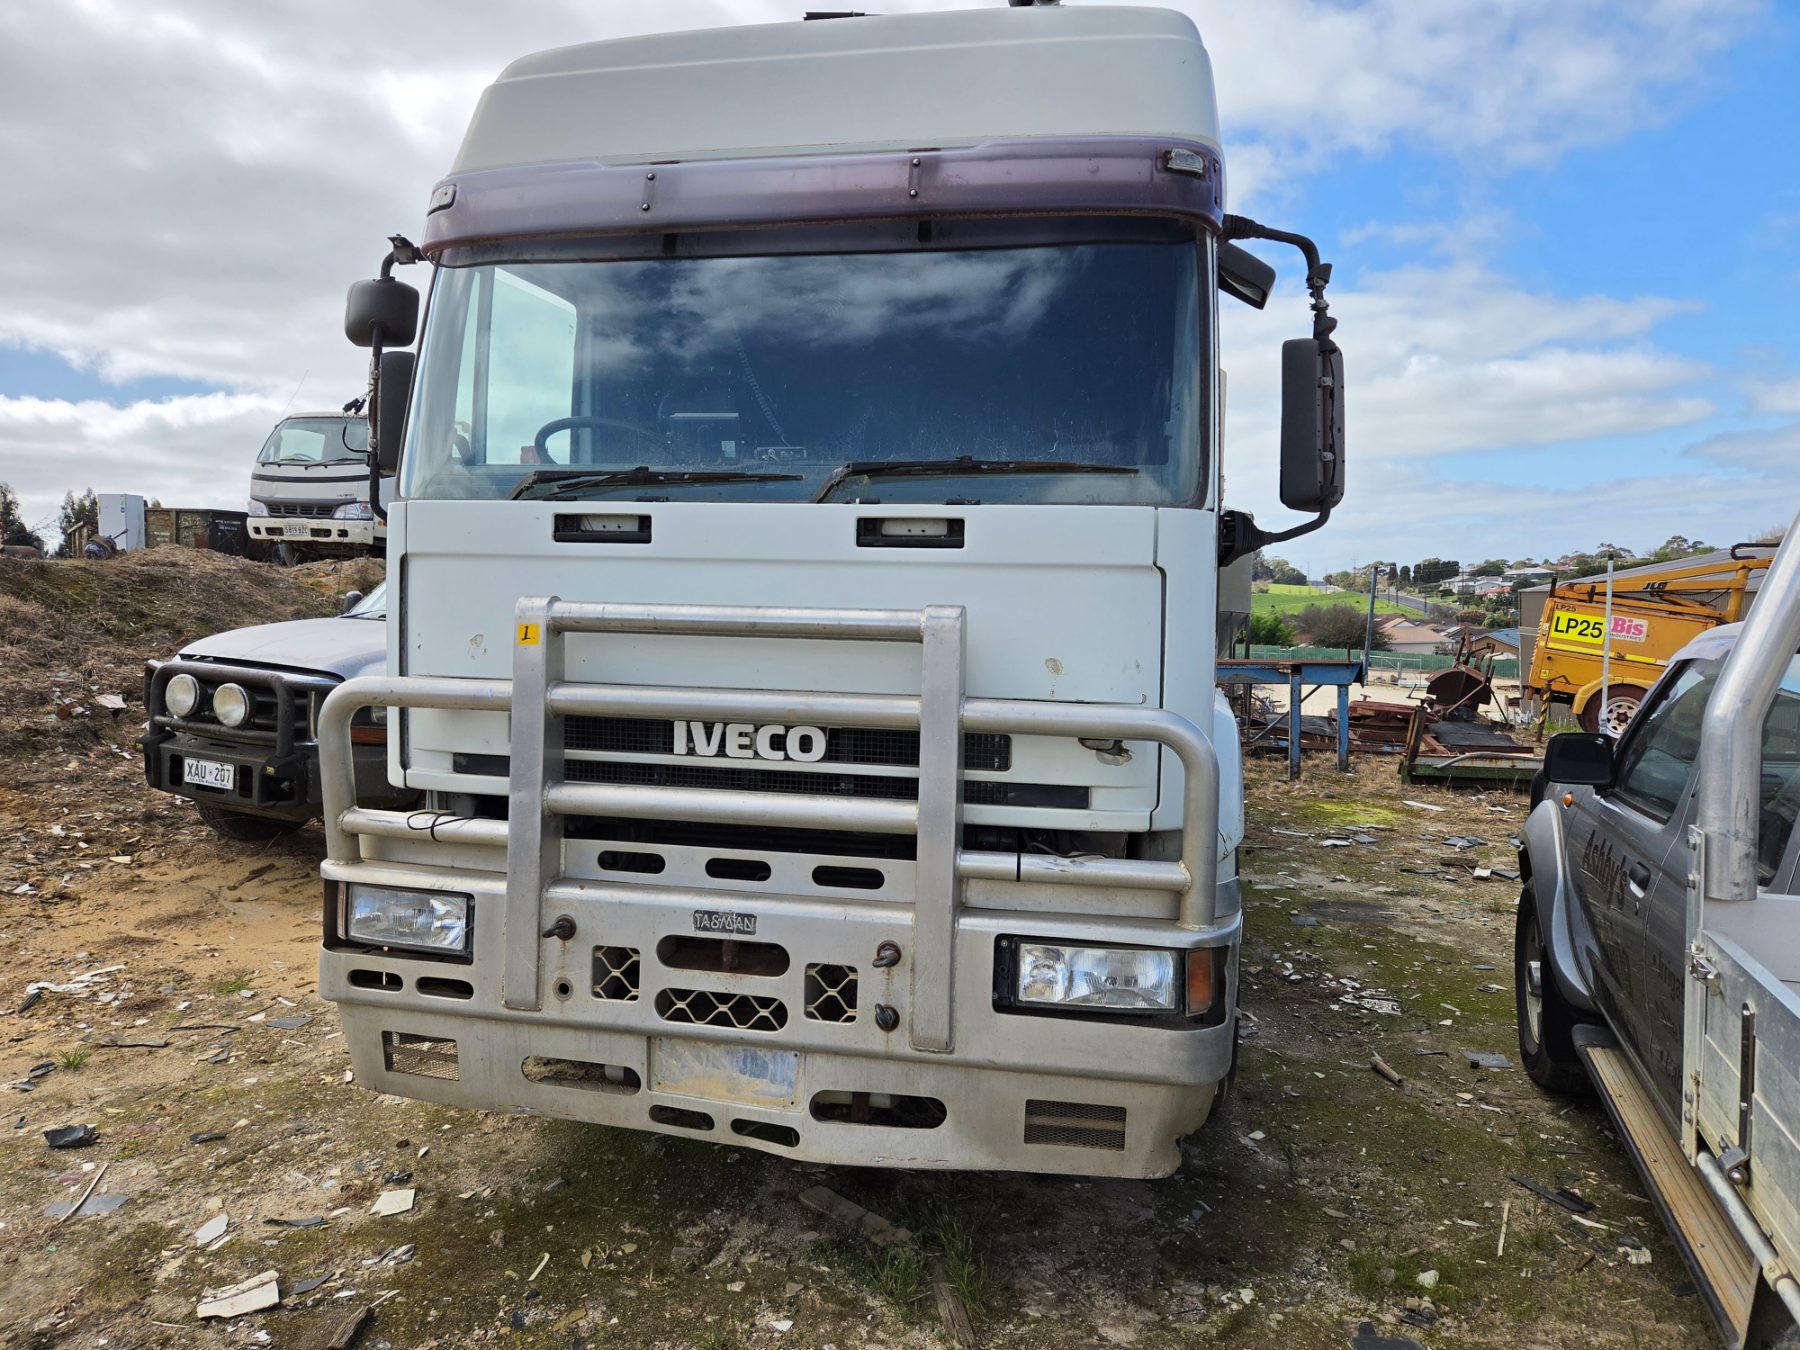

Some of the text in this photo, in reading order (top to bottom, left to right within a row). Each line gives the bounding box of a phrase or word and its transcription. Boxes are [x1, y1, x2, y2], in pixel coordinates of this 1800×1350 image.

[1556, 603, 1577, 612] LP25
[1554, 616, 1604, 639] LP25
[1611, 617, 1644, 636] Bis
[673, 720, 827, 762] IVECO
[187, 762, 231, 783] XAU 207
[1582, 829, 1628, 911] Ashby's
[695, 912, 755, 932] TASMAN
